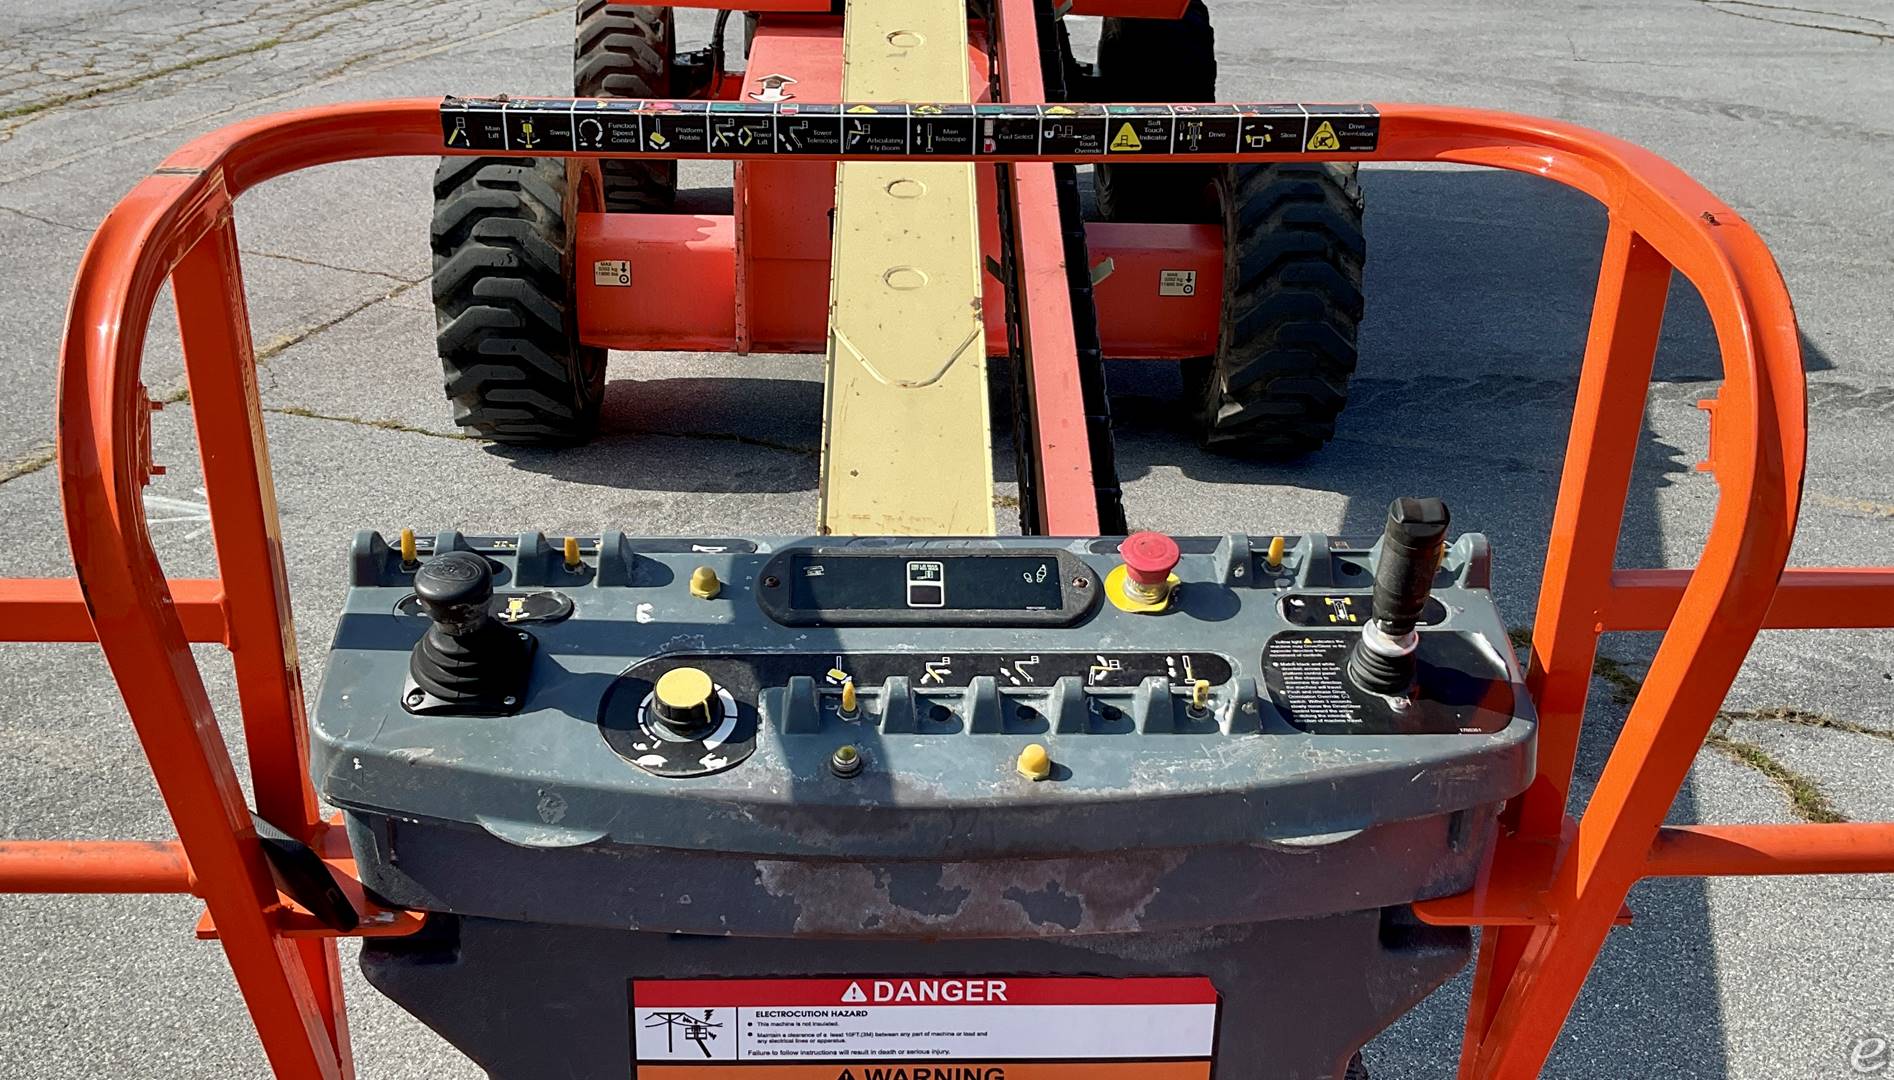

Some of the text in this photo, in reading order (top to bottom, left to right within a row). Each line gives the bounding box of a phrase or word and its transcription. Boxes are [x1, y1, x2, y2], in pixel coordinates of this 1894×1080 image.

[549, 130, 570, 138] Swing
[612, 130, 634, 138] Speed
[611, 137, 636, 145] Control
[807, 137, 839, 145] Telescope
[866, 137, 904, 146] Articulating
[935, 136, 967, 144] Telescope
[873, 980, 1008, 1002] DANGER
[865, 1067, 1004, 1080] WARNING
